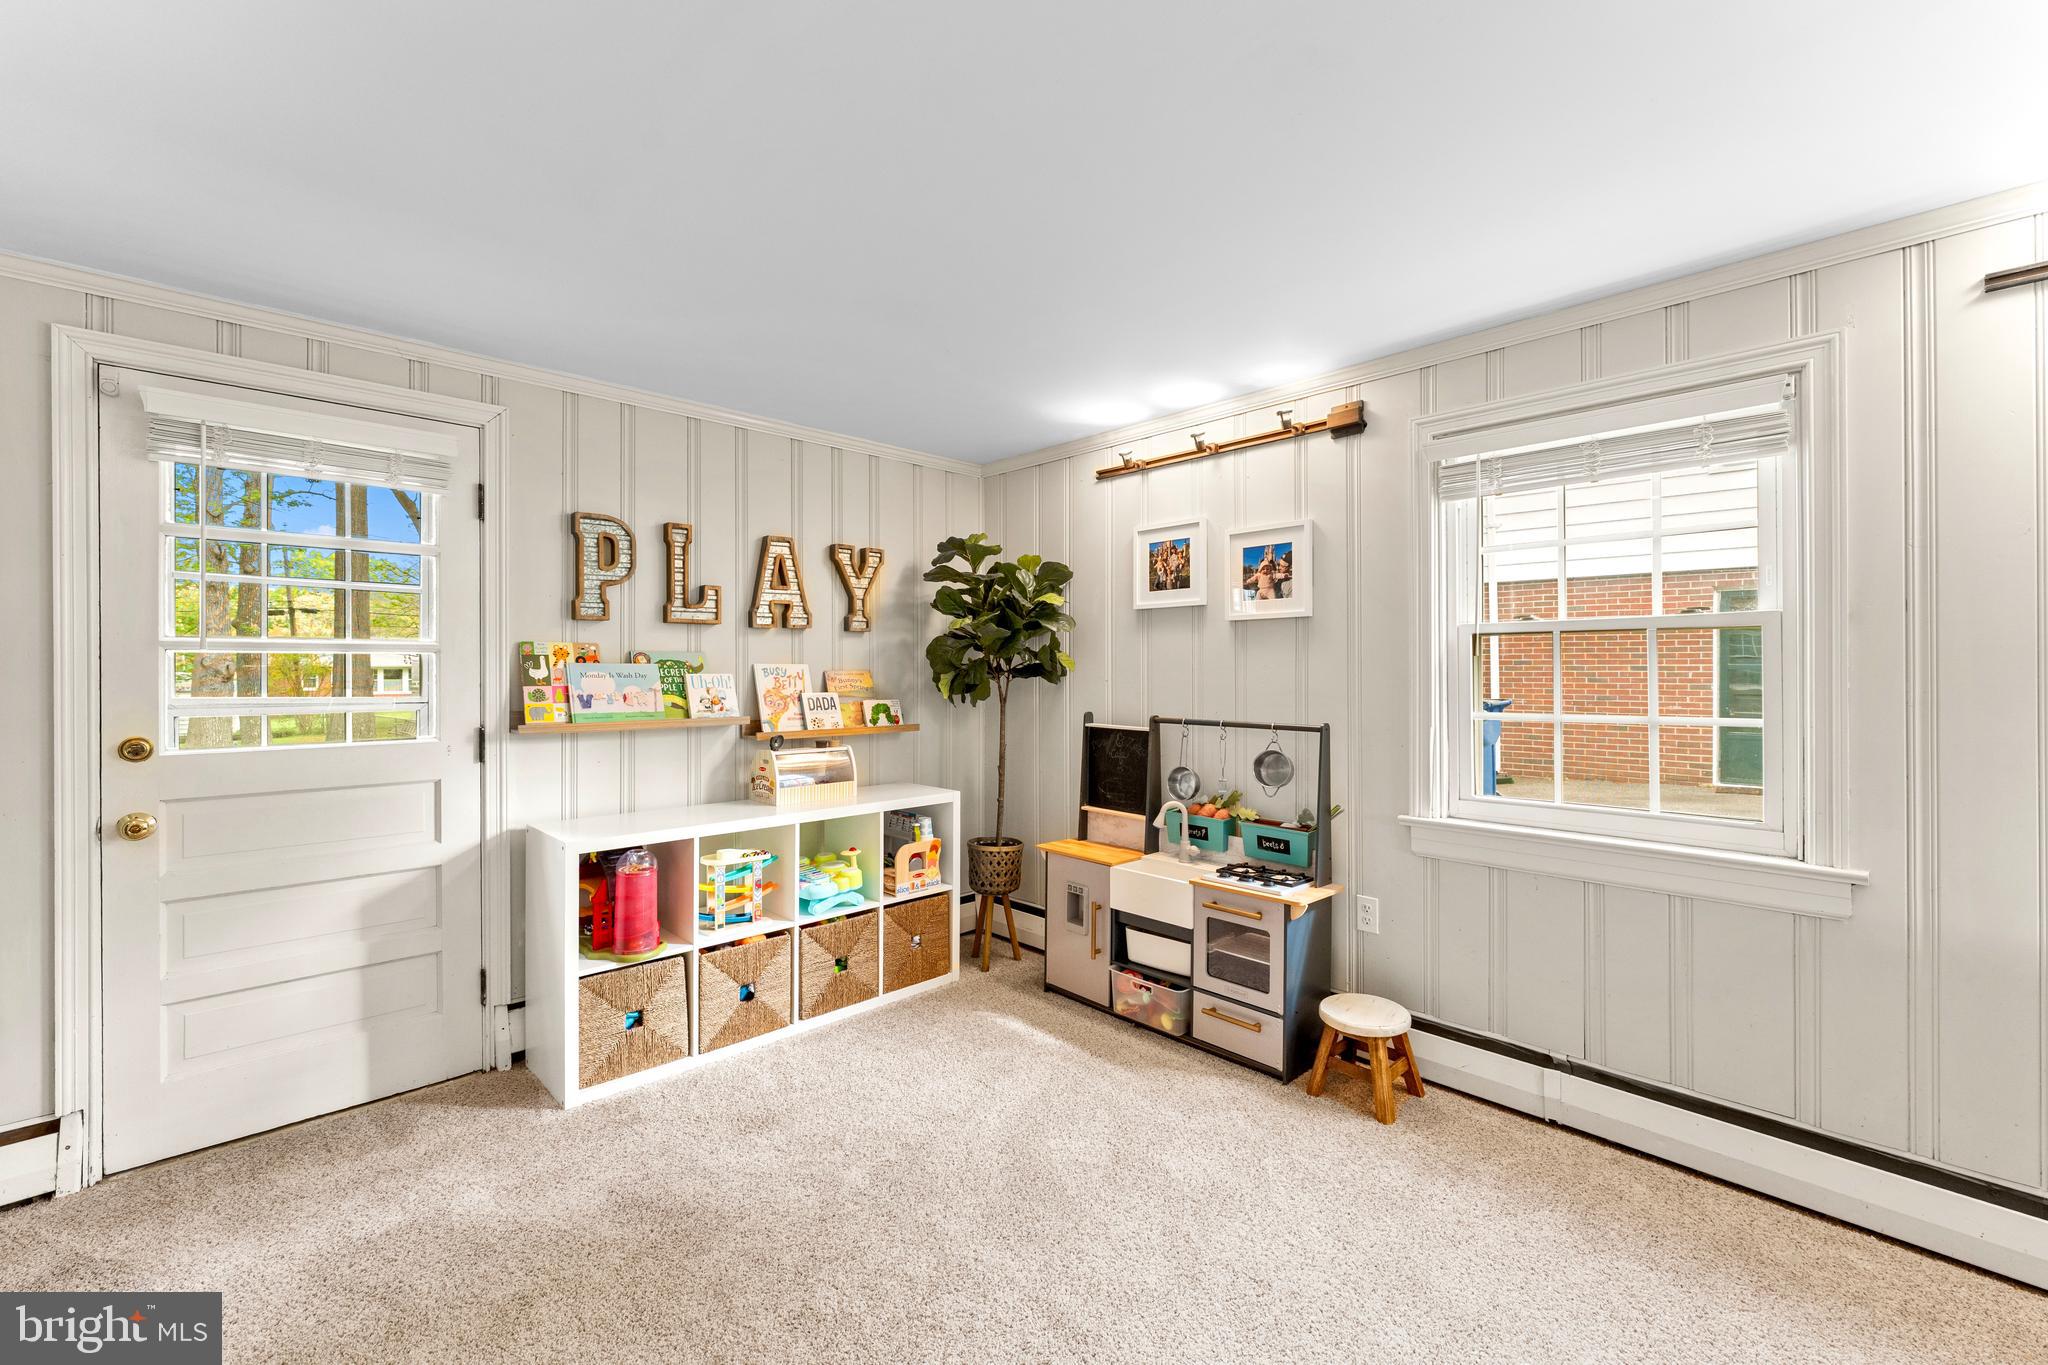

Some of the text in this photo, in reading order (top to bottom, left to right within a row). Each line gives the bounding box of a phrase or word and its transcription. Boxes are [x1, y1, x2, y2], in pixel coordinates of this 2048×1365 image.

[571, 511, 885, 632] PLAY
[579, 671, 606, 680] Monday
[634, 672, 648, 680] Day
[660, 668, 688, 677] ECRETS
[761, 666, 787, 678] BUSY
[690, 674, 732, 689] Uh-Oh!
[773, 669, 805, 690] BETTY
[660, 683, 678, 691] PPLE
[807, 696, 837, 711] DADA
[1262, 839, 1279, 849] beets
